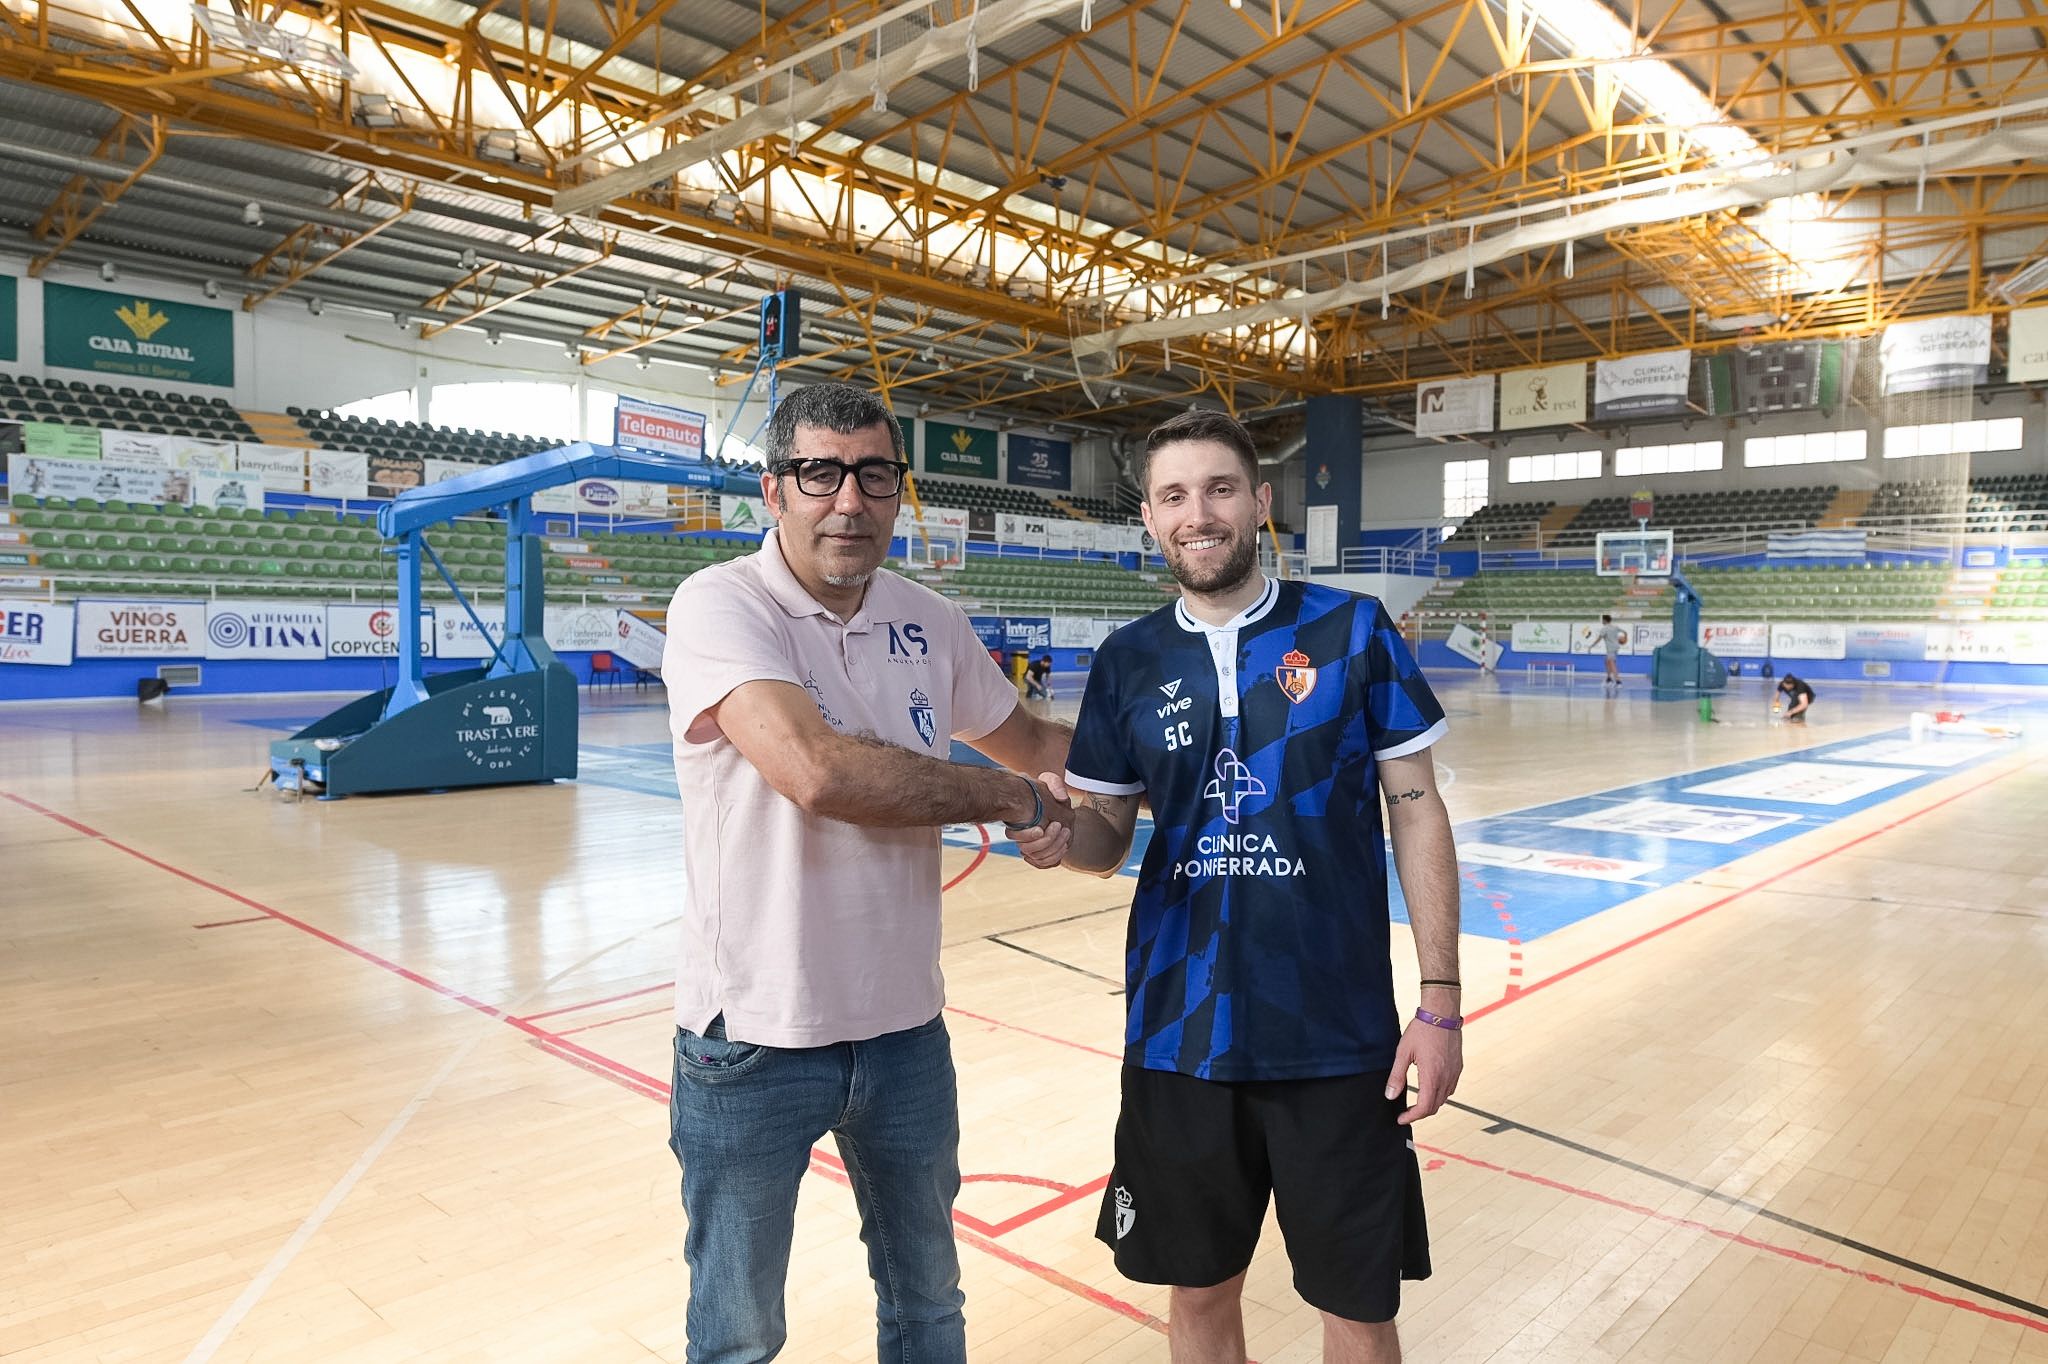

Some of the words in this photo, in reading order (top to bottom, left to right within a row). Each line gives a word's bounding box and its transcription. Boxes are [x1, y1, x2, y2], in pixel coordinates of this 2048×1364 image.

[88, 335, 133, 353] CAJA
[136, 341, 195, 361] RURAL
[1906, 340, 1987, 354] ONFERRADA
[2024, 352, 2048, 364] ca
[620, 415, 700, 445] Telenauto
[241, 461, 299, 473] sanyclima
[110, 611, 176, 627] VINOS
[1005, 619, 1036, 635] Intra
[97, 628, 187, 643] GUERRA
[249, 626, 322, 647] DIANA
[1027, 636, 1049, 649] gas
[331, 641, 430, 654] COPYCENO
[1157, 696, 1192, 719] vive
[456, 724, 539, 742] TRASTVERE
[1164, 720, 1193, 752] SC
[1173, 857, 1307, 880] PONFERRADA
